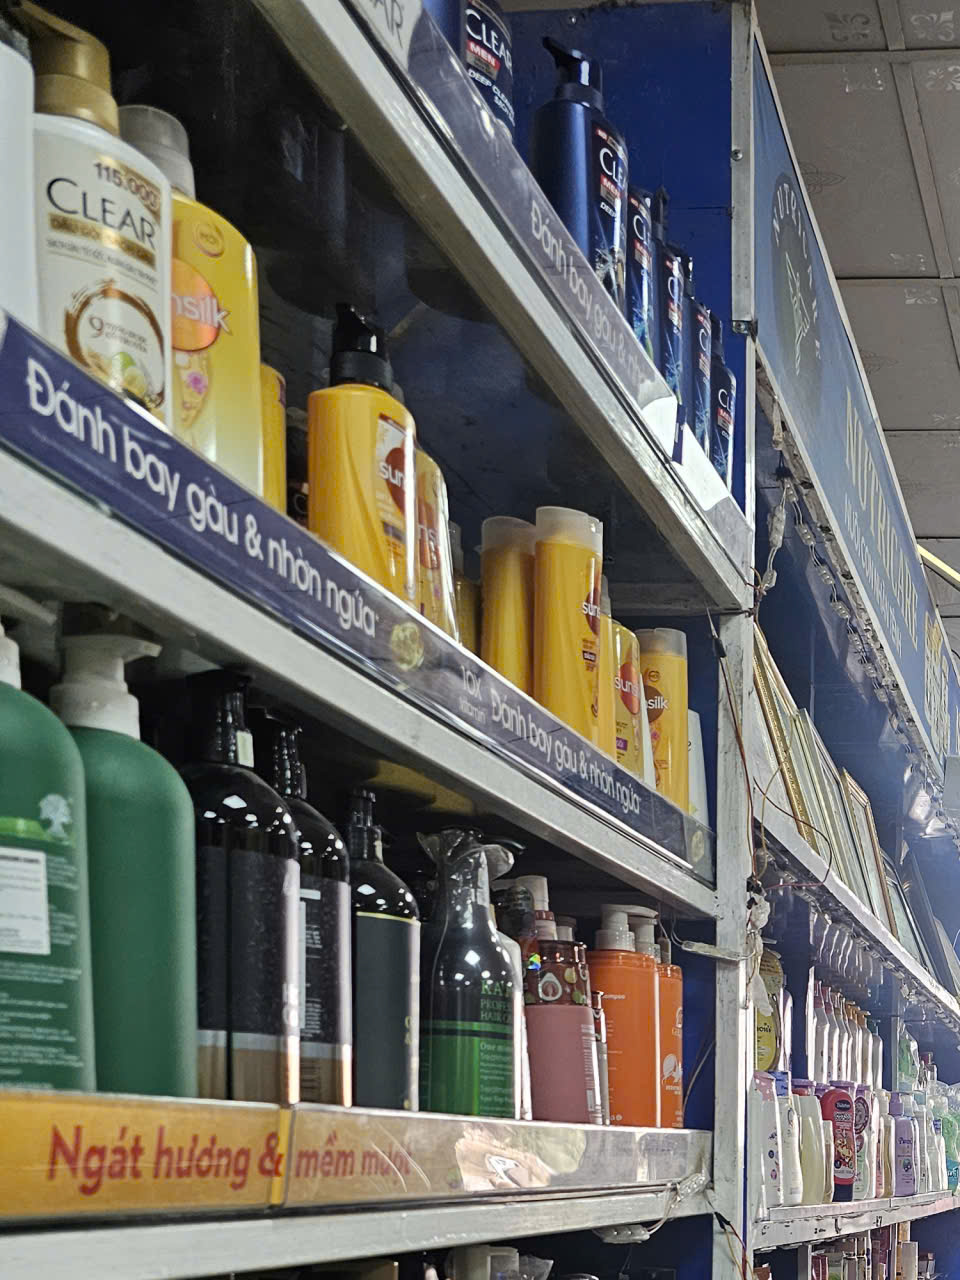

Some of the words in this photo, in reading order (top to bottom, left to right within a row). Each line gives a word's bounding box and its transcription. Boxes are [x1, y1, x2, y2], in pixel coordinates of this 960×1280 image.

[470, 42, 496, 67] MEN
[46, 177, 157, 251] CLEAR
[569, 257, 593, 320] bay
[27, 358, 117, 464] Đánh
[123, 426, 181, 512] bay
[186, 482, 239, 545] gàu
[244, 514, 264, 561] &
[268, 538, 322, 602] nhờn
[491, 688, 528, 738] Đánh
[528, 720, 553, 763] bay
[647, 696, 669, 710] silk
[47, 1117, 143, 1197] Ngát
[152, 1125, 252, 1191] hương
[256, 1131, 283, 1180] &
[295, 1129, 356, 1178] mềm
